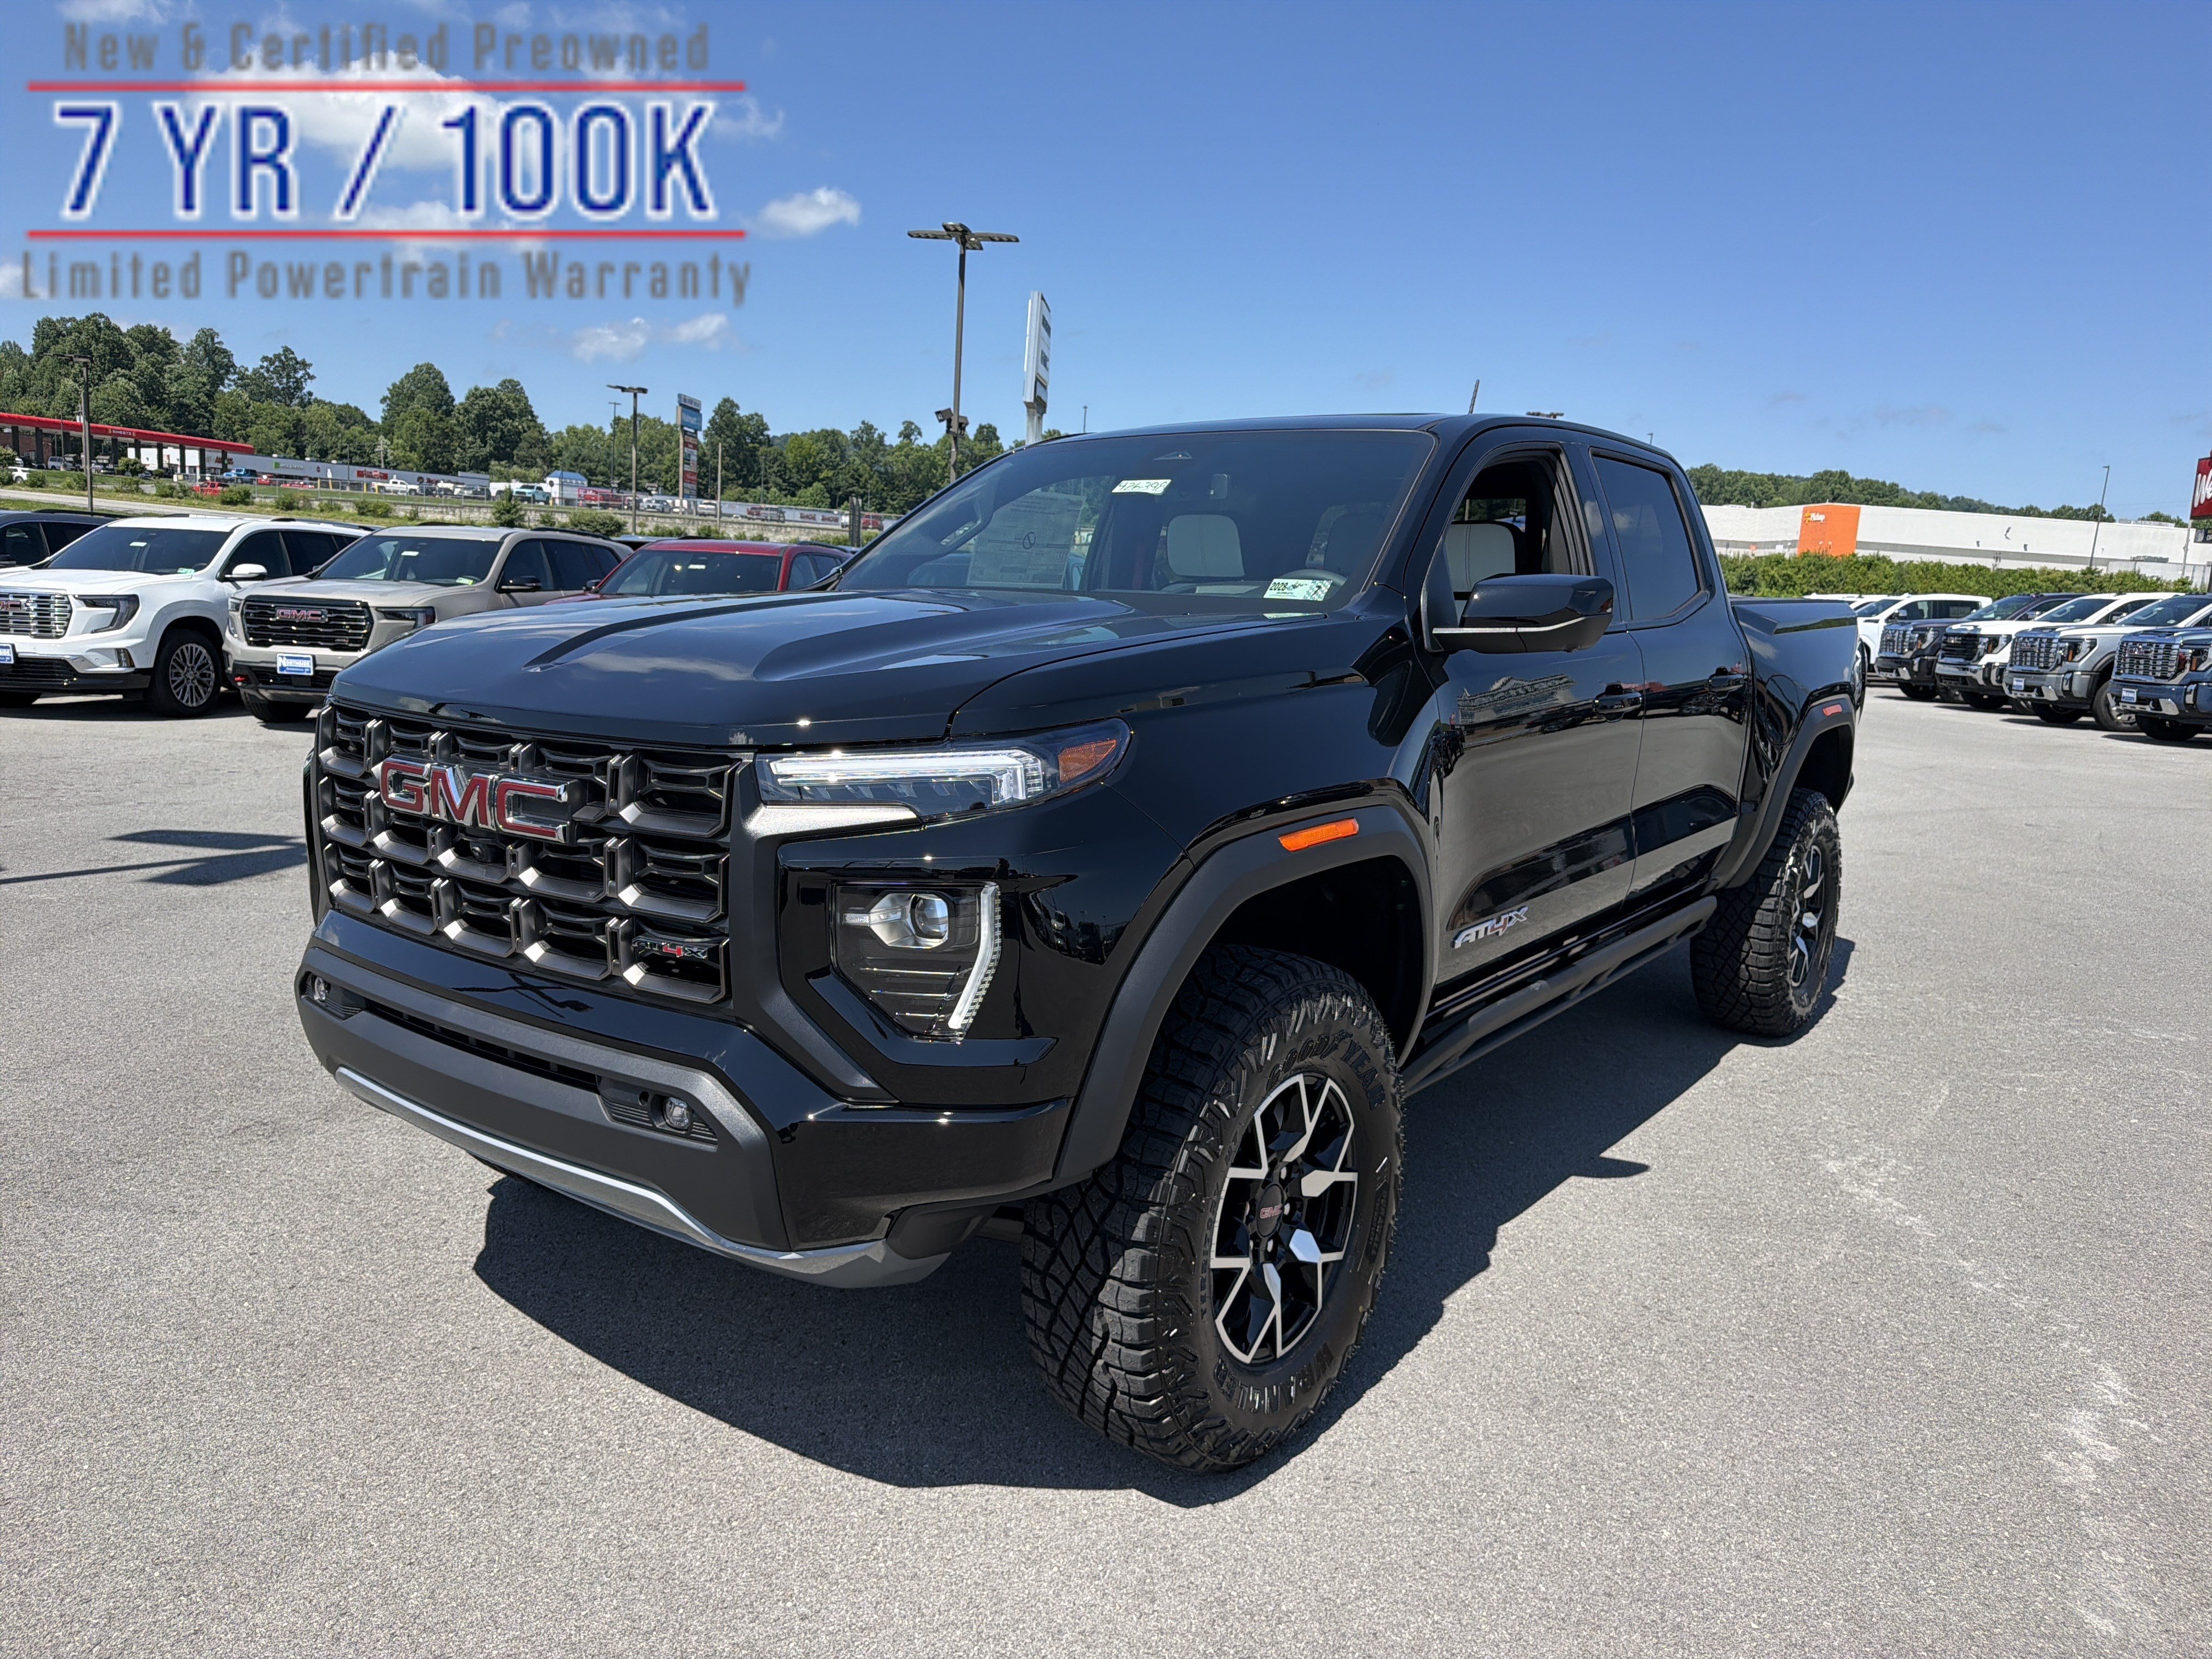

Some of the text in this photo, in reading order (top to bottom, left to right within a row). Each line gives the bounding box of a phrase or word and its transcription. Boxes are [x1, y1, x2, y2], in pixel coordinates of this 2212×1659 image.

[1269, 582, 1289, 591] 2028
[276, 608, 323, 622] GMC
[381, 757, 569, 844] GMC
[1453, 906, 1529, 949] AT4X
[1260, 1203, 1283, 1219] GMC
